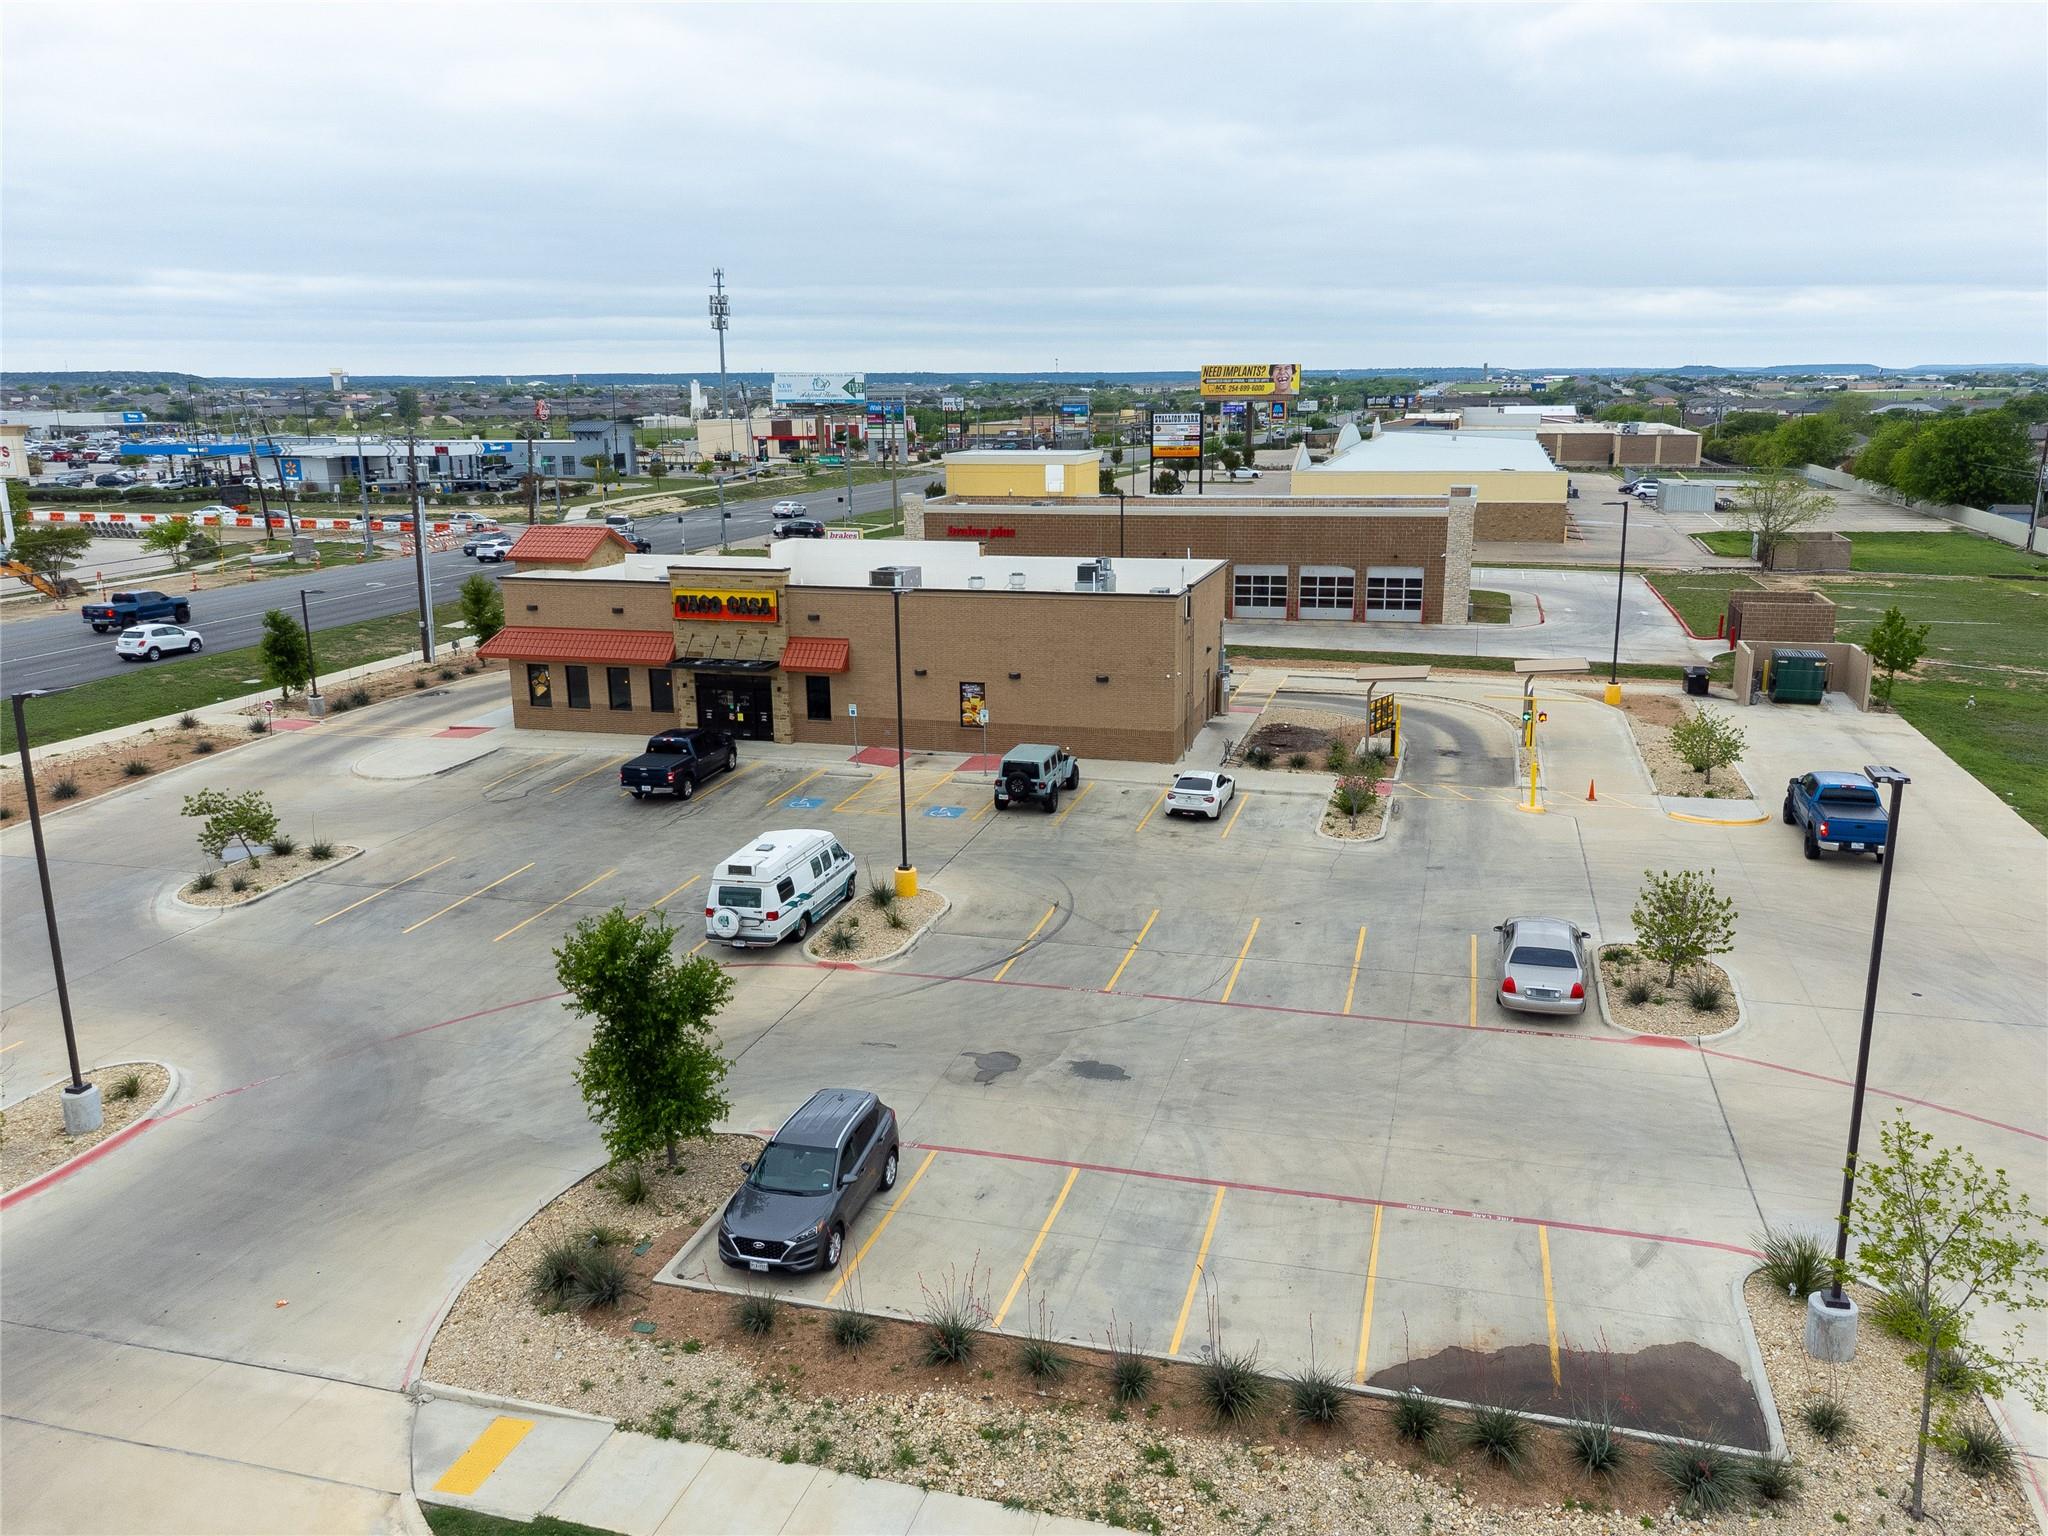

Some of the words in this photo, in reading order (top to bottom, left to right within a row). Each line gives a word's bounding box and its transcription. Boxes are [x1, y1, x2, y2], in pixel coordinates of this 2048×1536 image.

[1203, 366, 1222, 377] NEED
[1223, 366, 1266, 377] IMPLANTS?
[1155, 415, 1181, 423] STALLION
[1184, 415, 1199, 423] PARK
[829, 532, 857, 541] brakes
[947, 526, 988, 538] brakes
[676, 595, 722, 614] TACO
[727, 596, 771, 616] CASA
